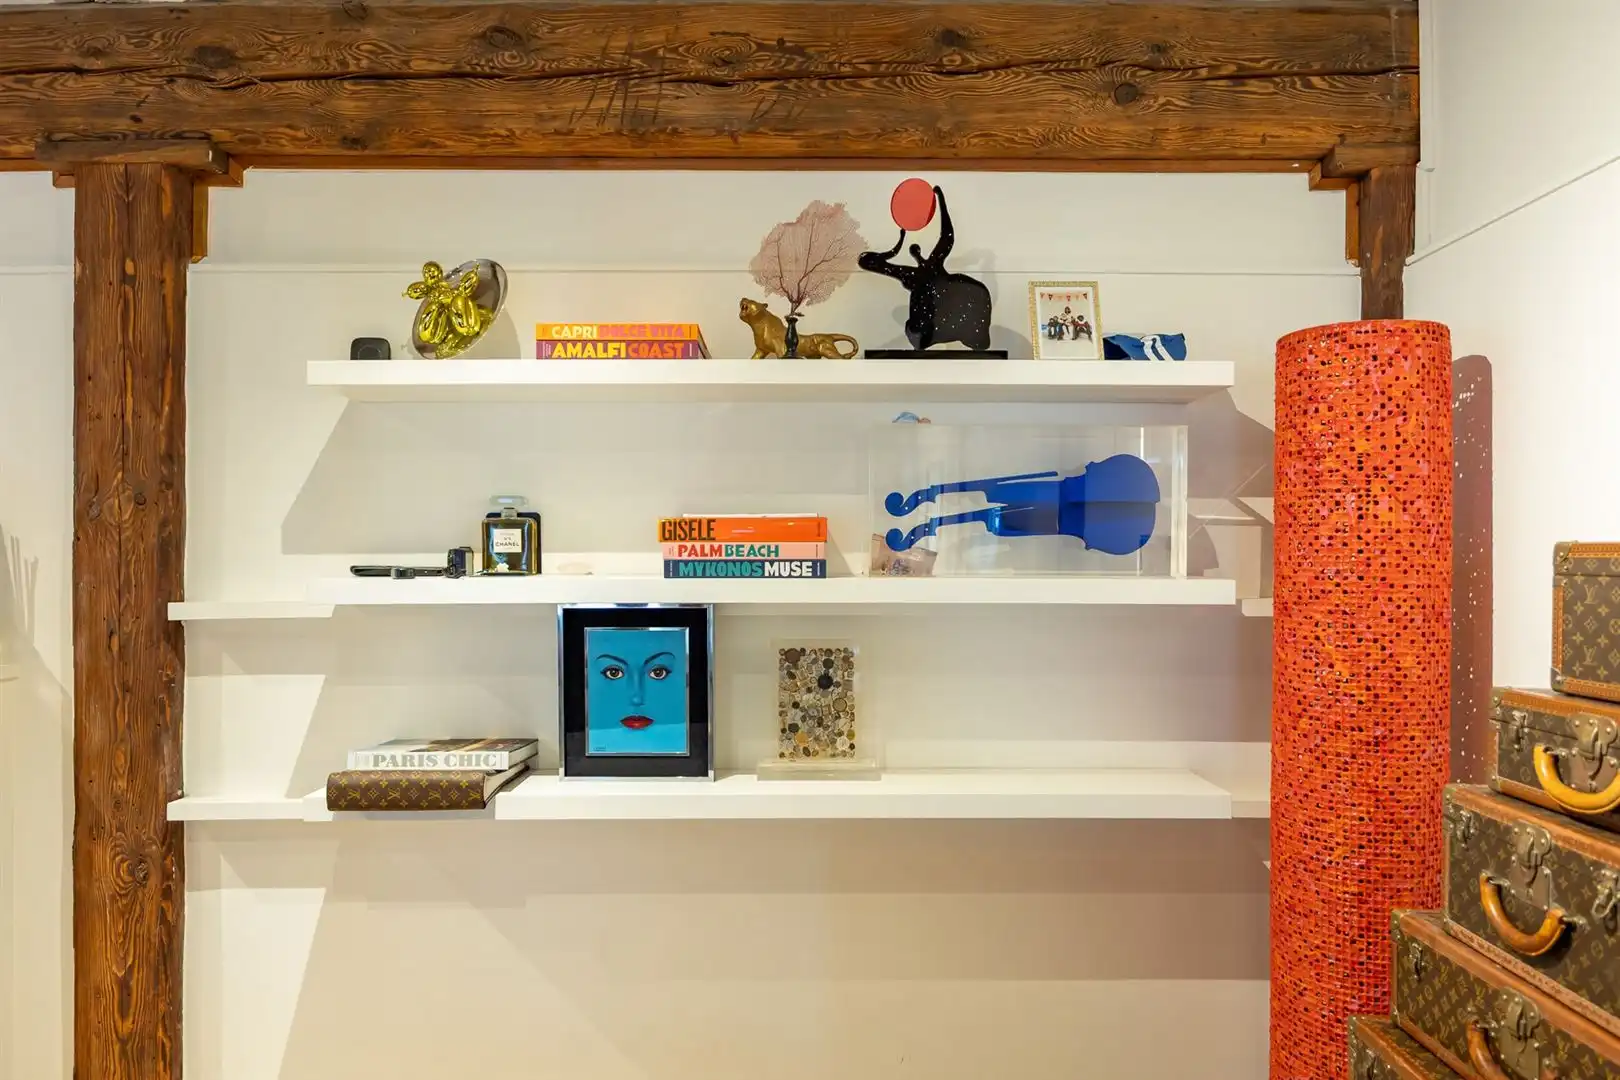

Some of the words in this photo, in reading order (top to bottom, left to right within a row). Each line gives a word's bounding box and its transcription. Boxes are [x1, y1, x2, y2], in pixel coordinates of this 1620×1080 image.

[551, 326, 597, 339] CAPRI
[551, 342, 626, 359] AMALFI
[628, 342, 684, 359] COAST
[661, 519, 716, 541] GISELE
[677, 544, 723, 558] PALM
[724, 544, 780, 558] BEACH
[679, 561, 763, 577] MYKONOS
[764, 561, 813, 577] MUSE
[372, 754, 439, 768] PARIS
[443, 754, 497, 768] CHIC
